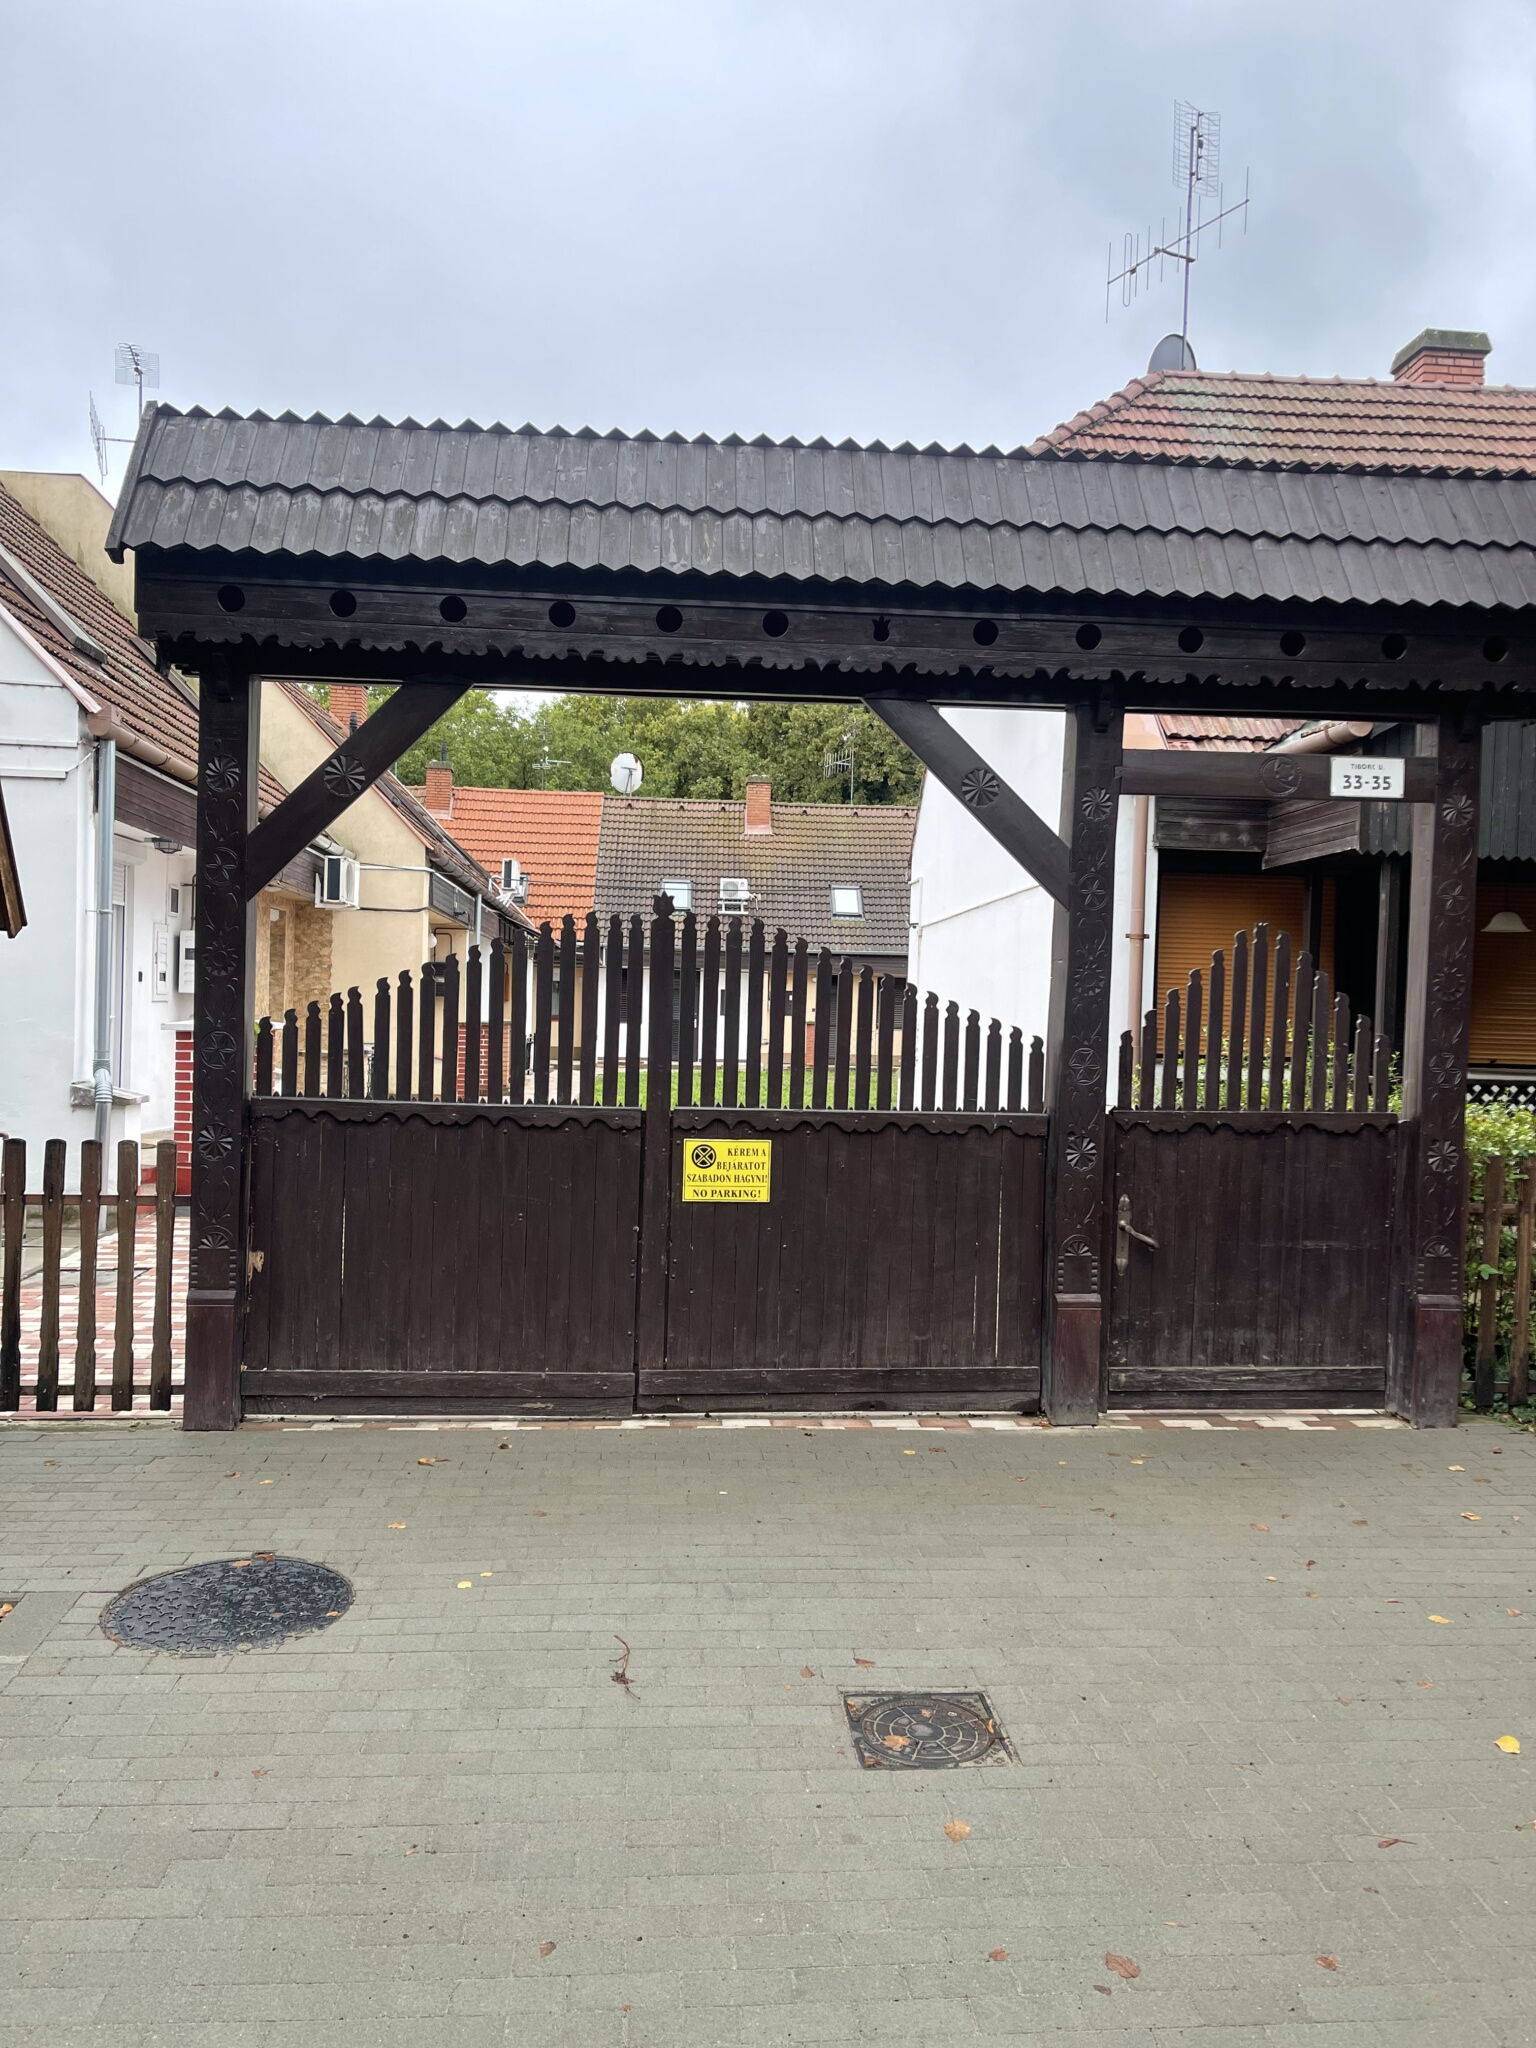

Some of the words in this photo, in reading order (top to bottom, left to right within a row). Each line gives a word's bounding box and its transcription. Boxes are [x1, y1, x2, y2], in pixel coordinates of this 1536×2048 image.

[1343, 774, 1391, 791] 33-35
[727, 1145, 759, 1157] KÉREM
[760, 1148, 767, 1157] A
[716, 1159, 766, 1172] BEJÁRATOT
[686, 1173, 731, 1183] SZABADON
[733, 1174, 768, 1184] HAGYNI!
[692, 1188, 708, 1198] NO
[711, 1189, 761, 1199] PARKING!
